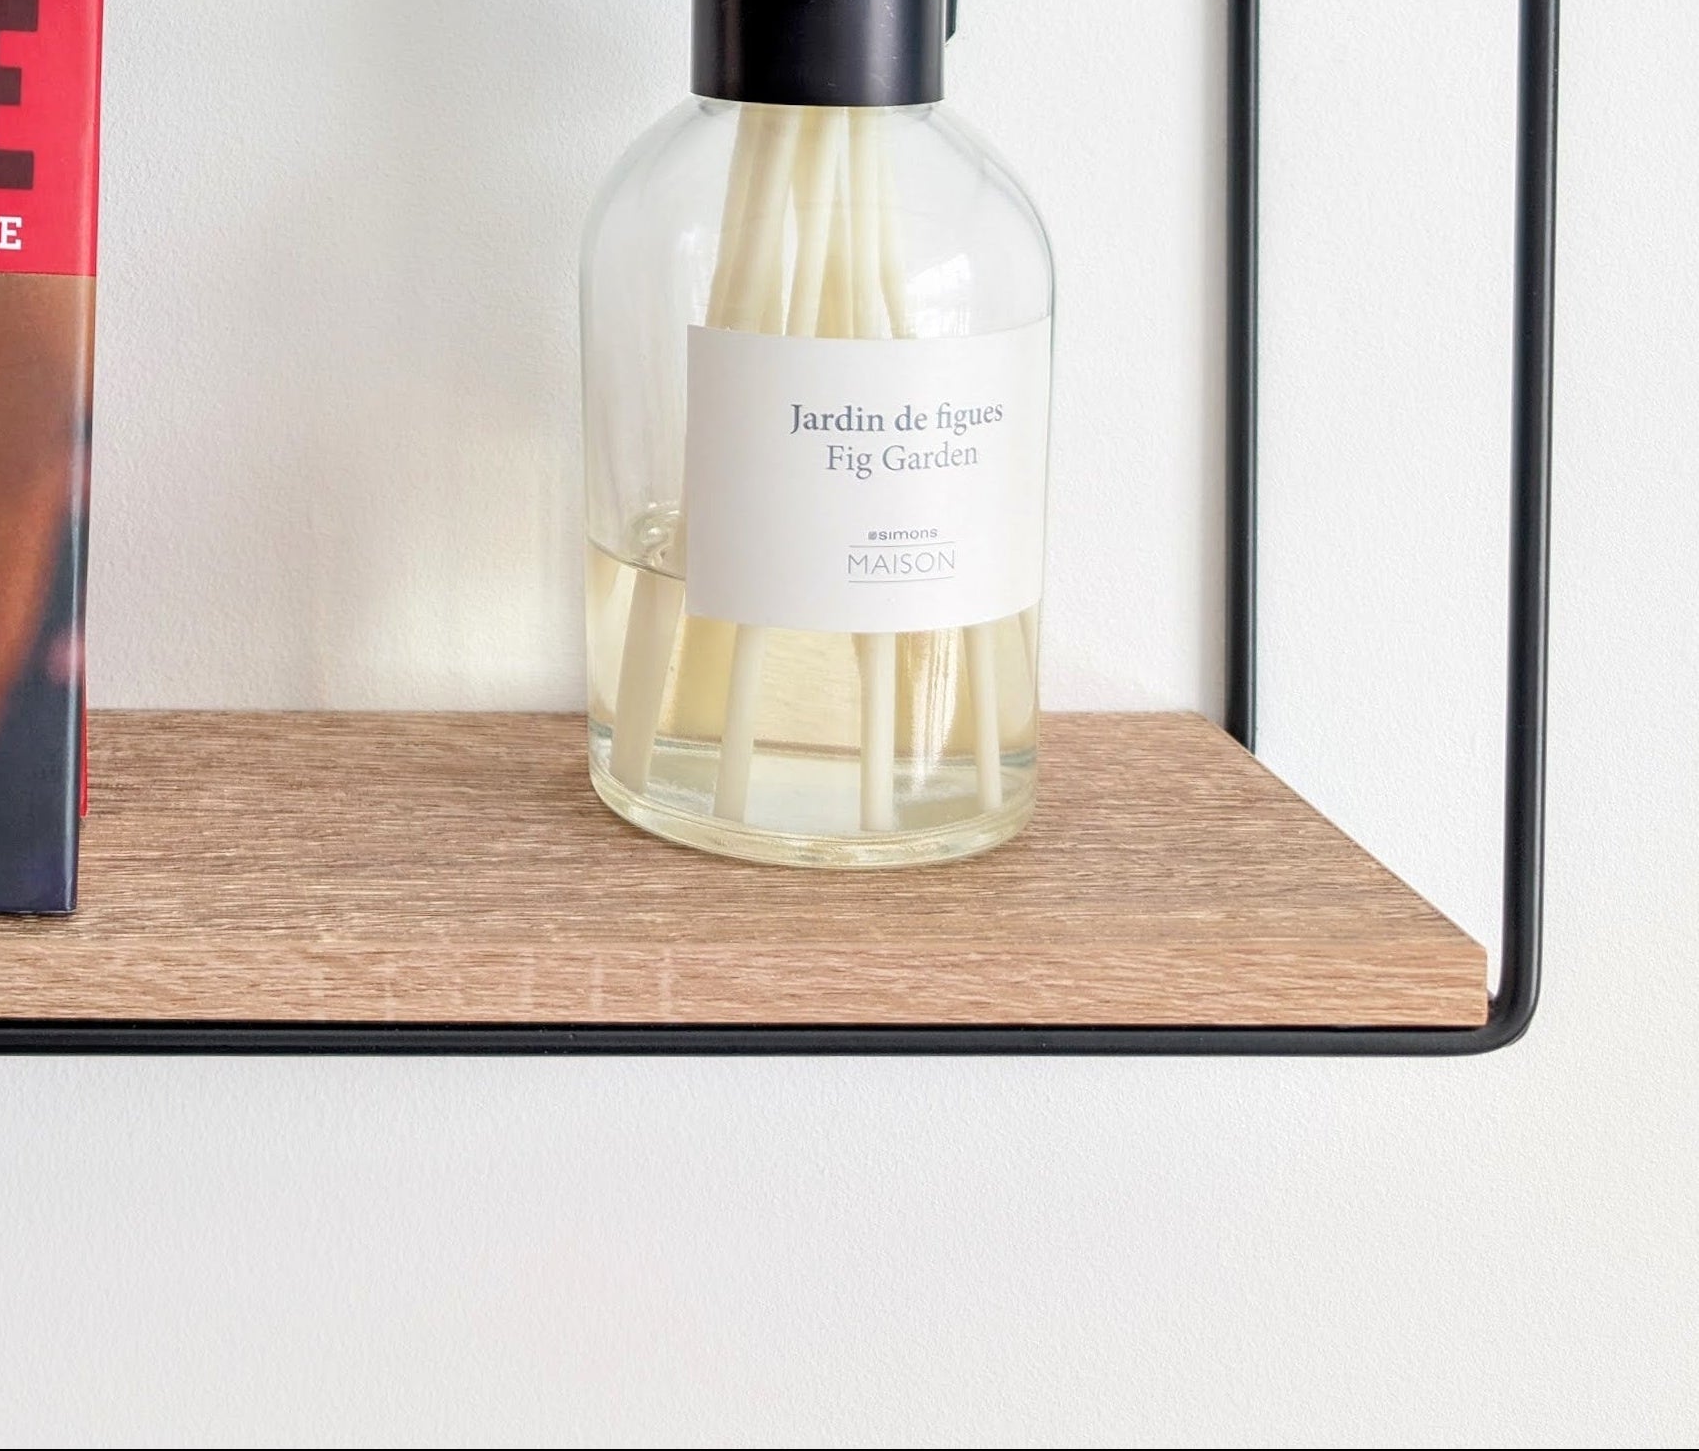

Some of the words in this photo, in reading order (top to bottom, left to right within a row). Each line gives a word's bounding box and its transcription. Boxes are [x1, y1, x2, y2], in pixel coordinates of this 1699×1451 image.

[789, 403, 886, 435] Jardin
[893, 404, 928, 432] de
[935, 401, 1003, 437] figues
[825, 444, 873, 481] Fig
[881, 441, 978, 472] Garden
[847, 549, 955, 575] MAISON
